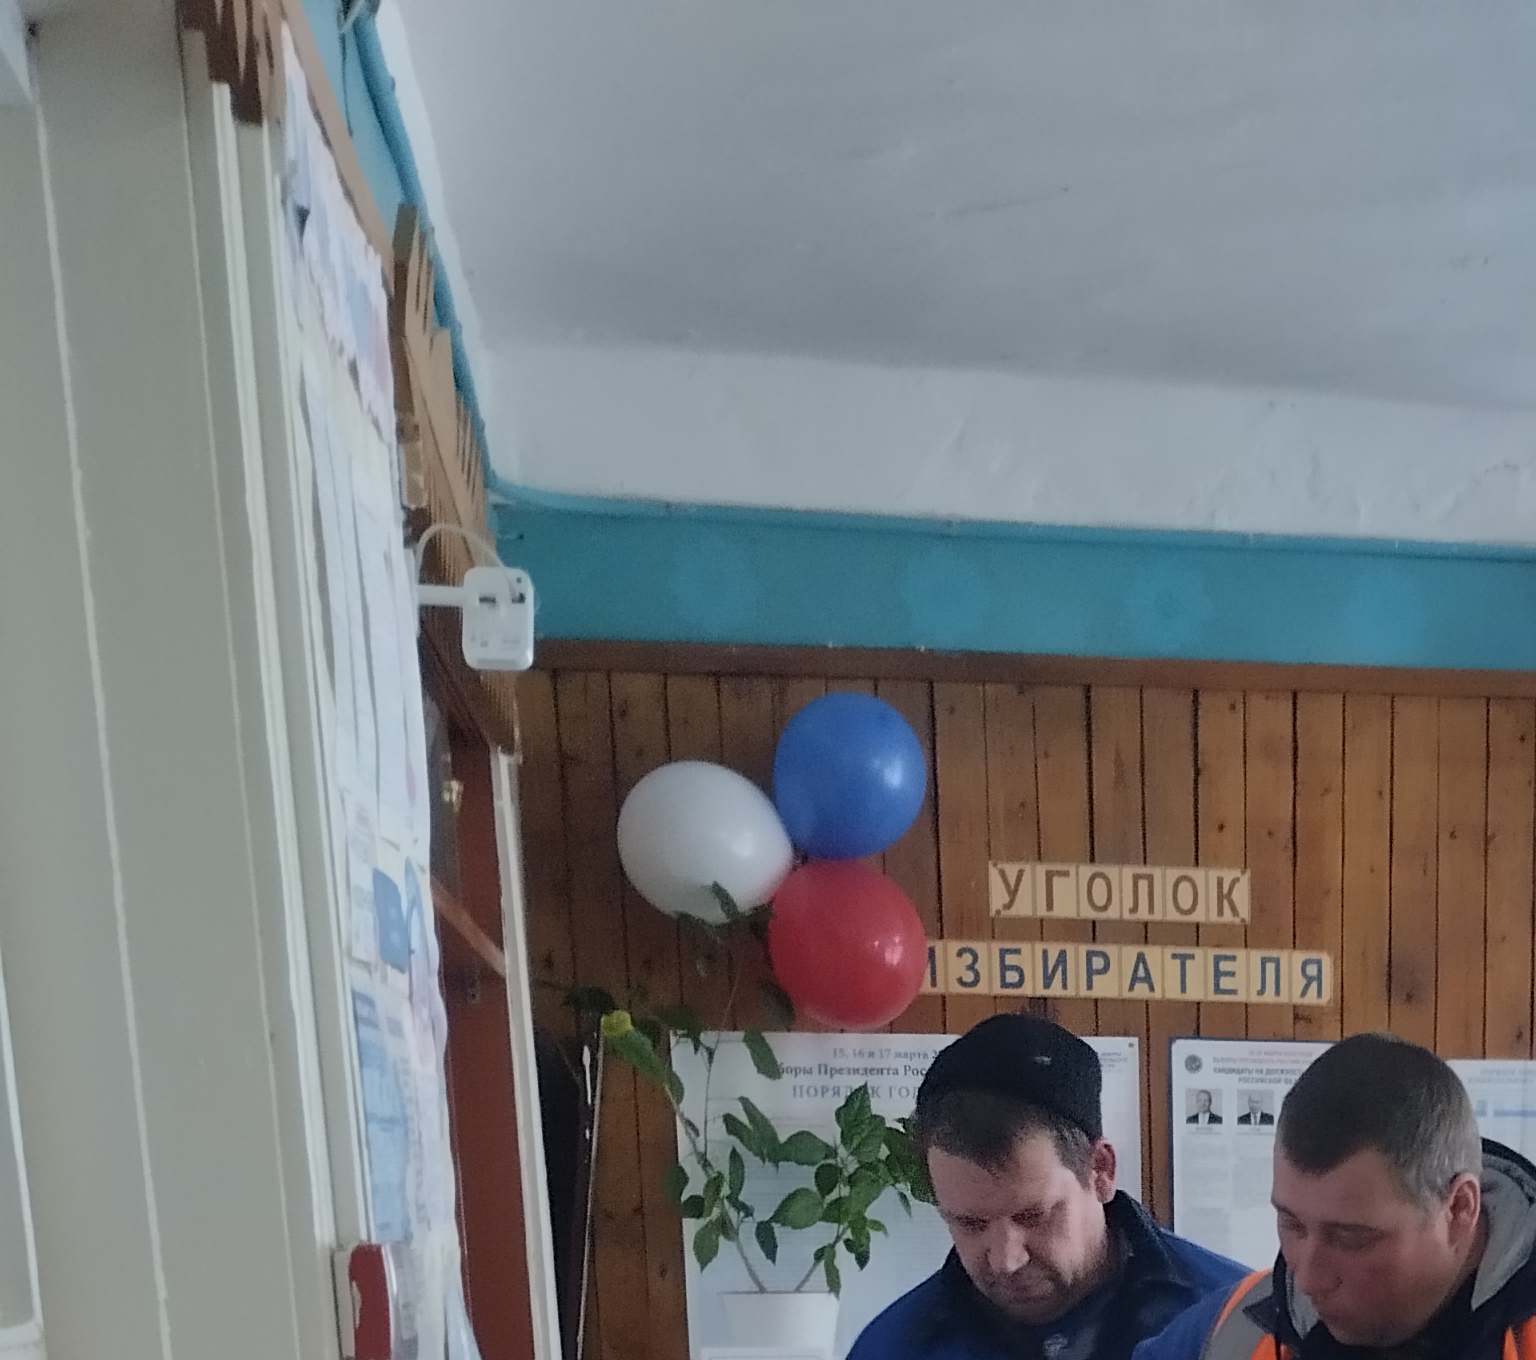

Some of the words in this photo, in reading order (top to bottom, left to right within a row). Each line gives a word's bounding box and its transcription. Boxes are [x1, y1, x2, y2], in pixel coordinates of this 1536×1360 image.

[999, 868, 1241, 918] УГОЛОК
[878, 1048, 892, 1059] 17
[817, 1063, 899, 1079] Президента
